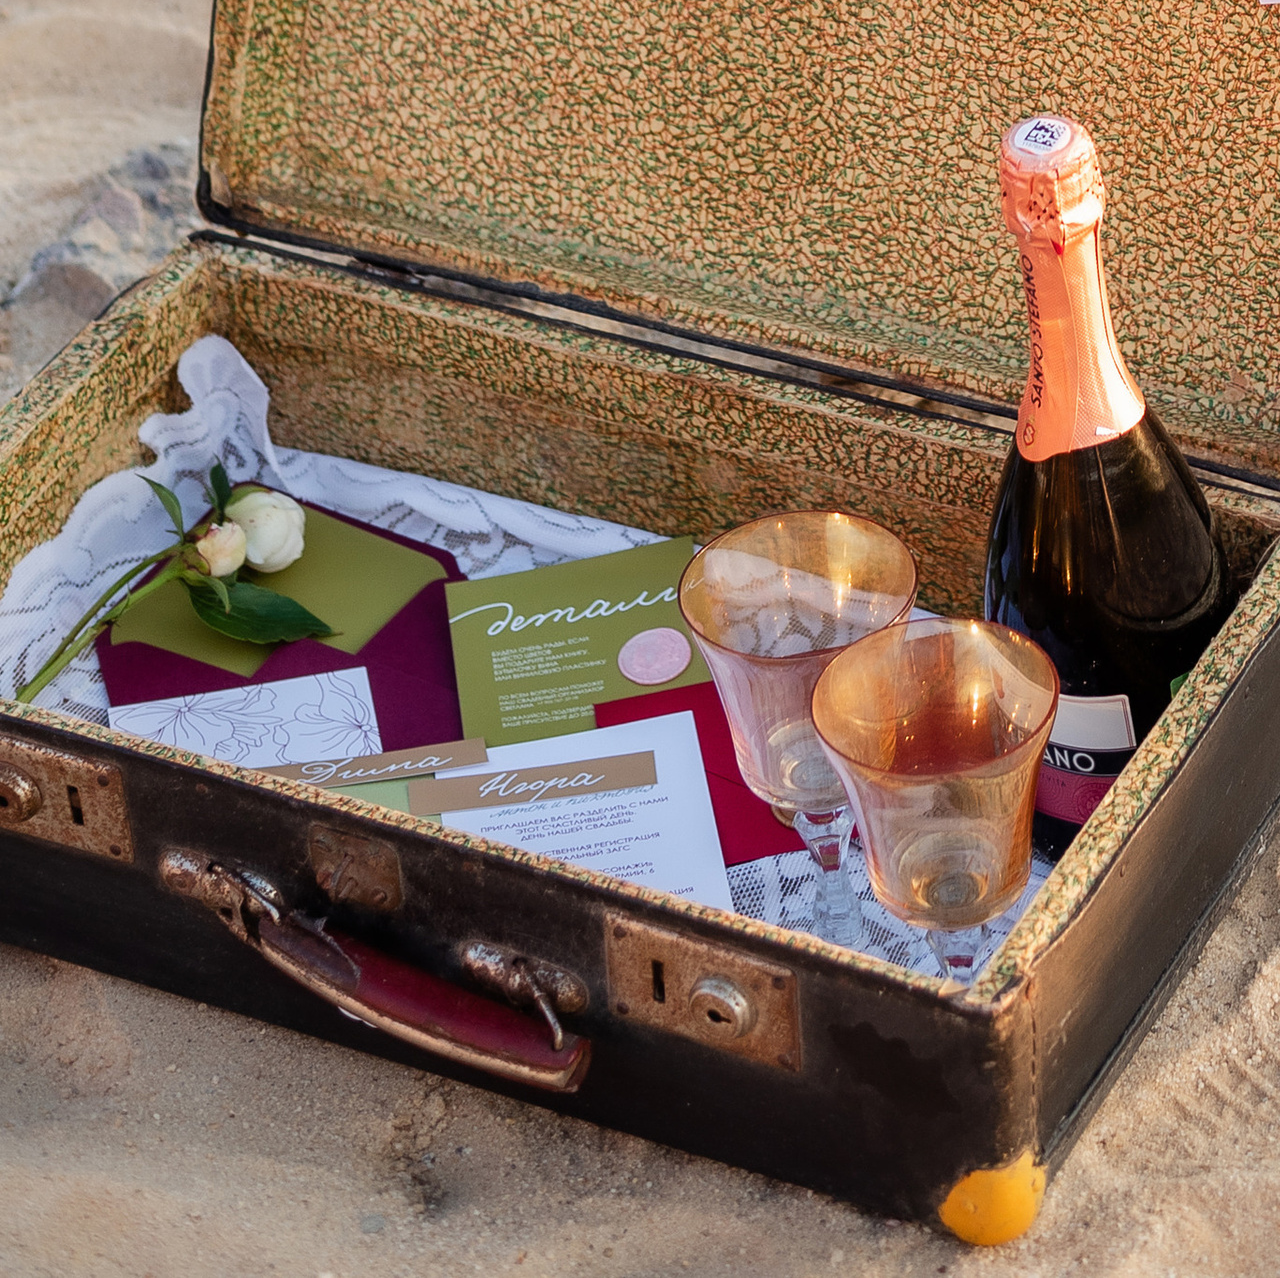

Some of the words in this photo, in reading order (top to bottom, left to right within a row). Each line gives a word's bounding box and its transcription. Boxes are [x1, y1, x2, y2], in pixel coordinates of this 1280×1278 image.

[1021, 254, 1042, 340] STEFANO
[1030, 342, 1044, 409] SANTO
[480, 818, 548, 833] ПРИГЛАШАЕМ
[550, 812, 572, 823] ВАС
[573, 804, 627, 819] РАЗДЕЛИТЬ
[628, 801, 638, 810] С
[639, 796, 669, 808] НАМИ
[515, 825, 541, 836] ЭТОТ
[541, 815, 607, 831] СЧАСТЛИВЫЙ
[520, 832, 546, 842] ДЕНЬ
[547, 825, 584, 837] НАШЕЙ
[594, 832, 661, 849] РЕГИСТРАЦИЯ
[605, 845, 631, 854] ЗАГС
